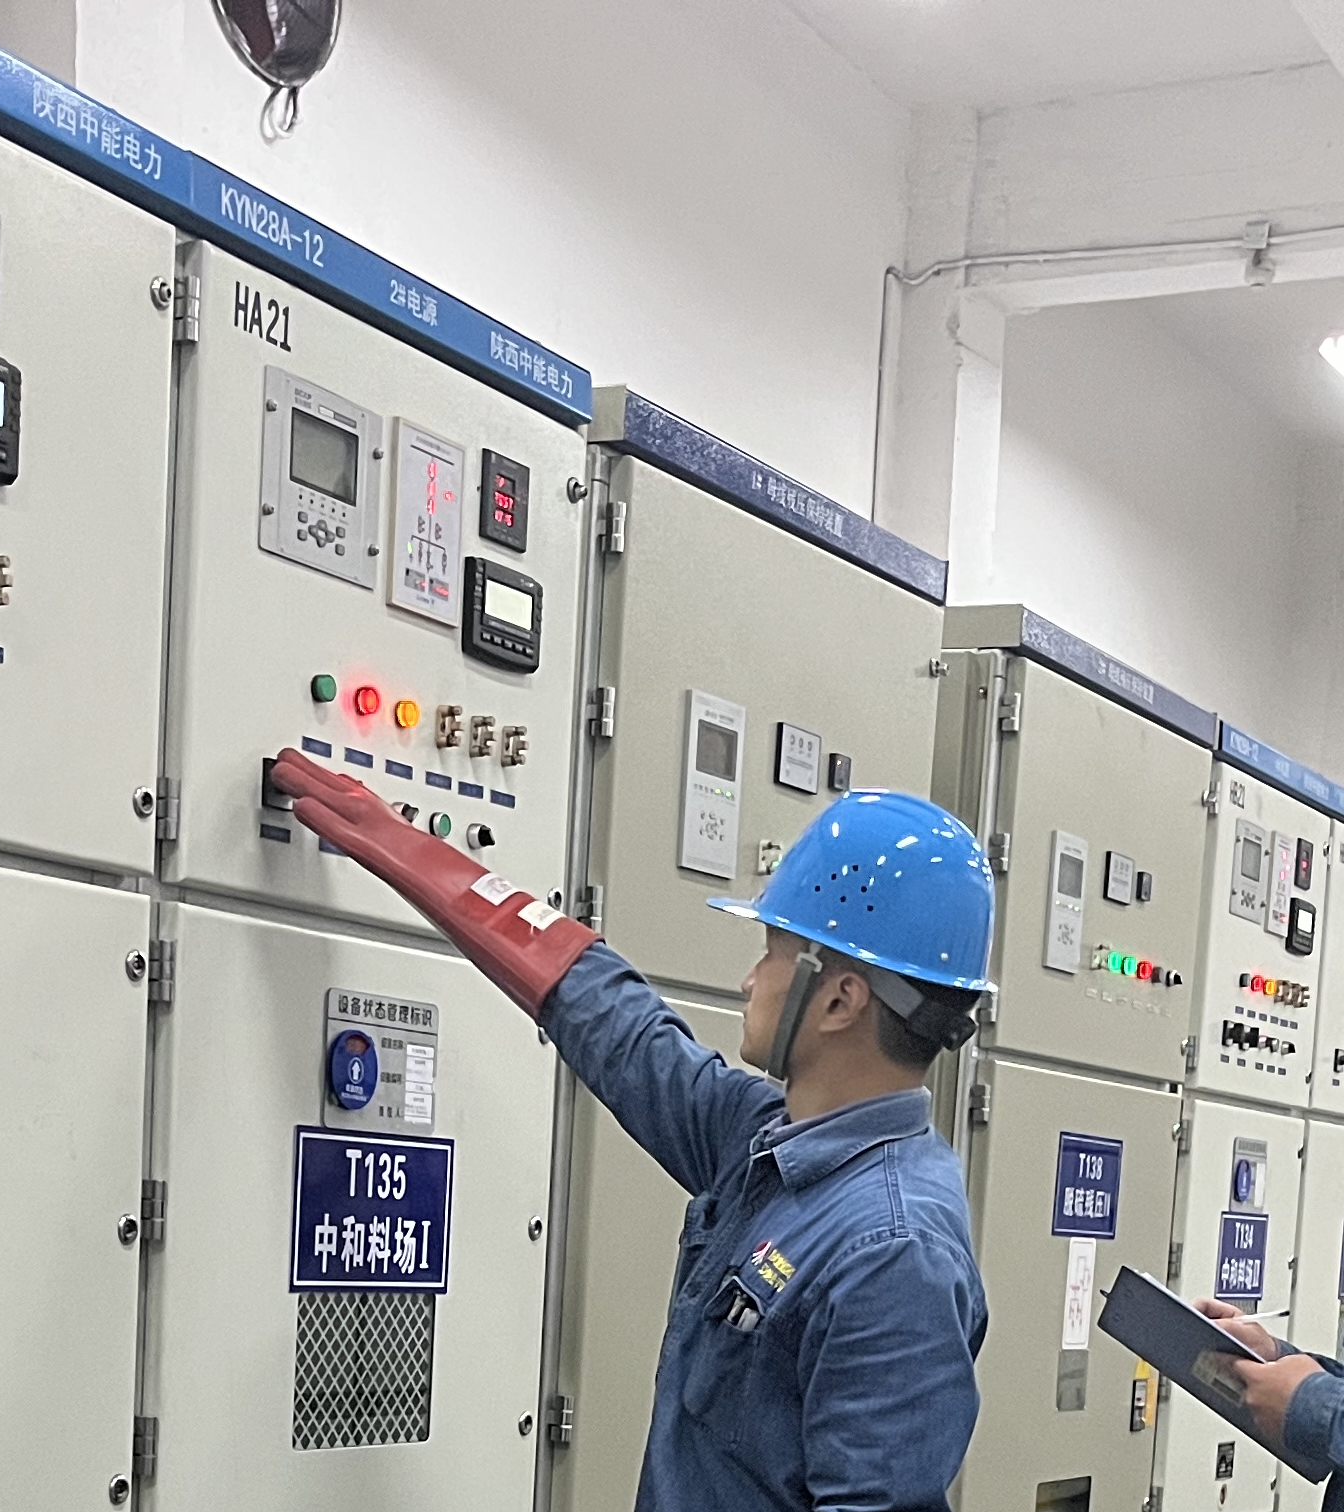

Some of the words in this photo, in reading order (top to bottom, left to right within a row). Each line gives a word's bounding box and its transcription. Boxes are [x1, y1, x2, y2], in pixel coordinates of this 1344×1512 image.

[32, 80, 162, 181] 陕西中能电力
[221, 183, 324, 267] KYN28A-12
[390, 279, 439, 327] 2#电源
[490, 330, 573, 400] 陕西中能电力
[234, 280, 292, 353] HA21
[338, 994, 433, 1028] 设备状态管理标识
[345, 1148, 407, 1200] T135
[1078, 1153, 1104, 1181] T138
[1234, 1222, 1254, 1250] T134
